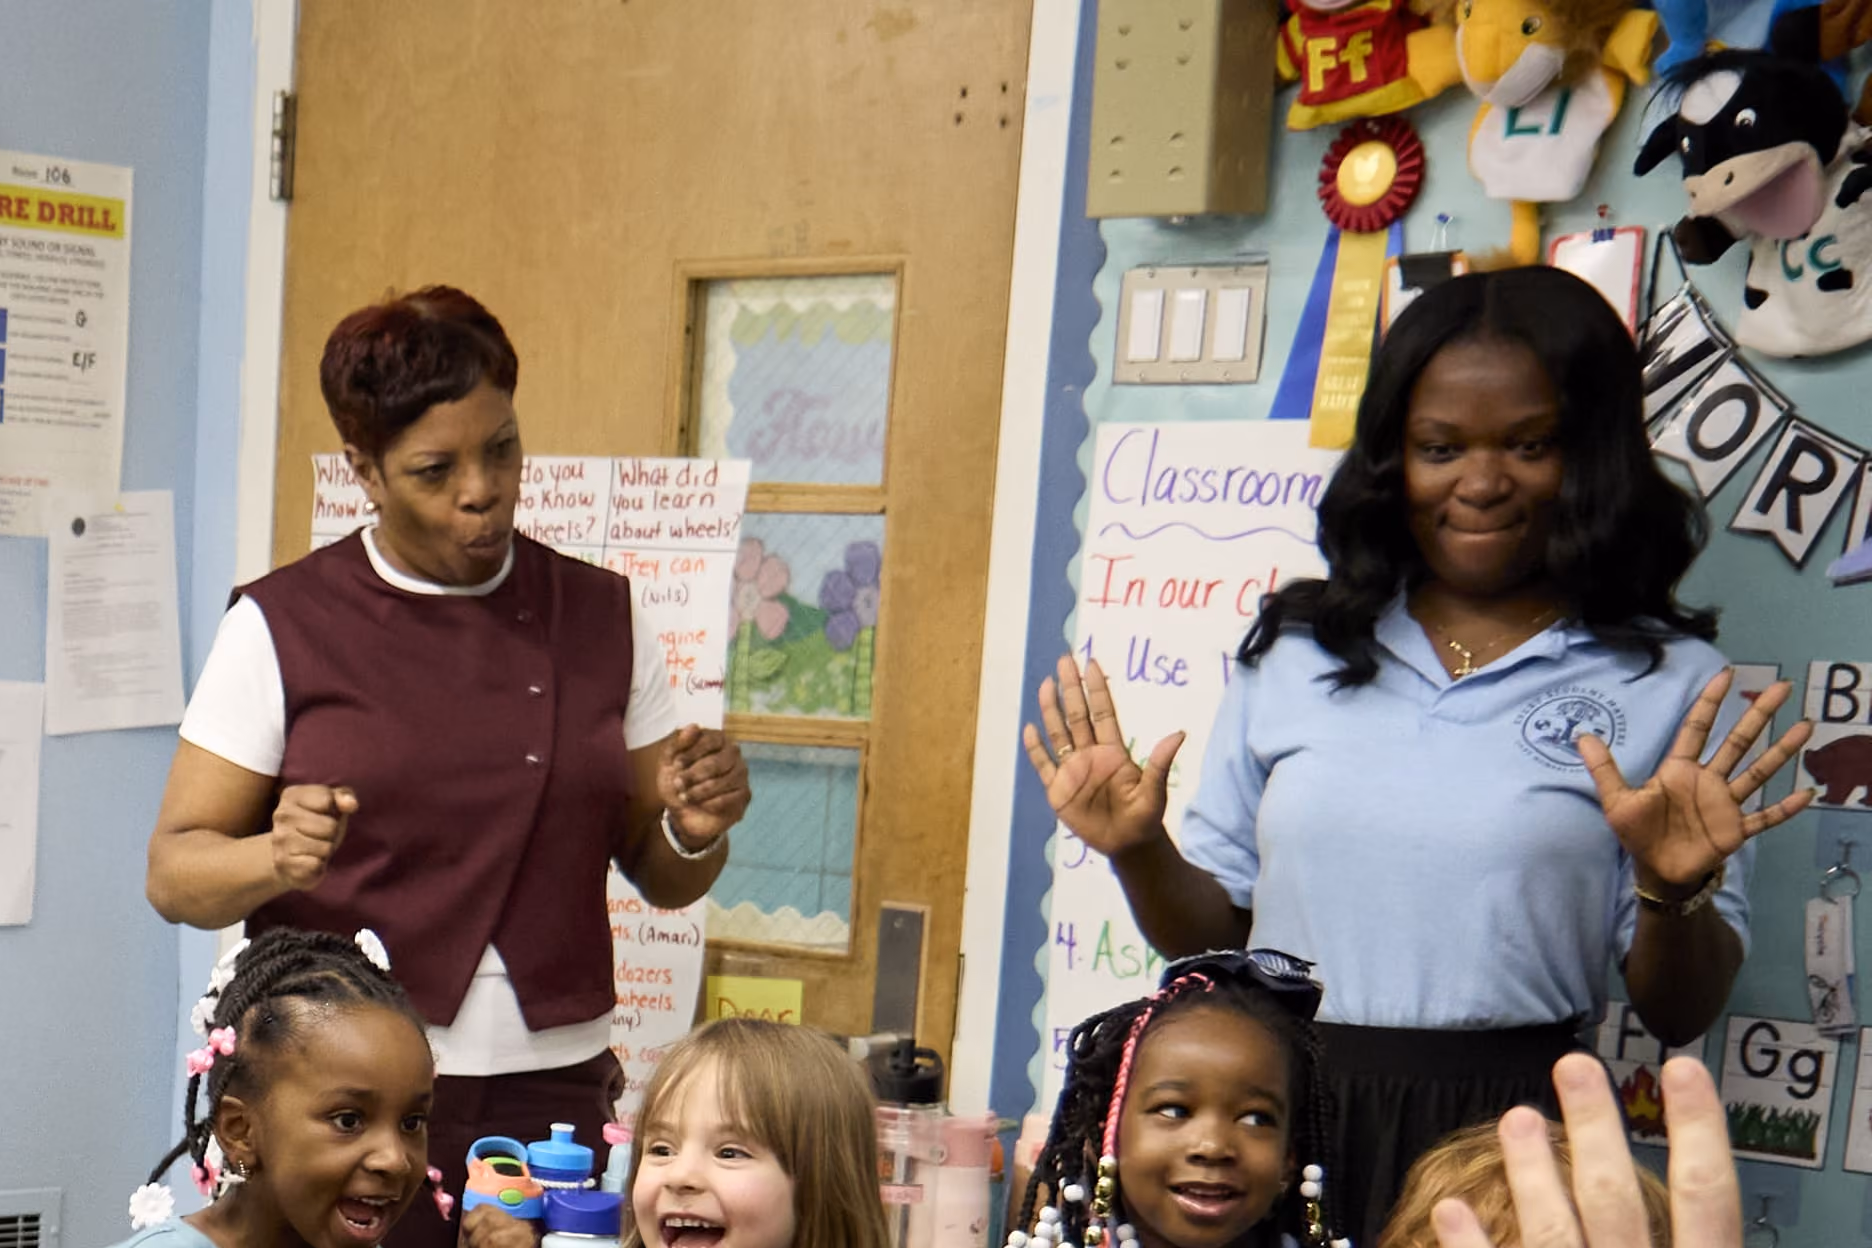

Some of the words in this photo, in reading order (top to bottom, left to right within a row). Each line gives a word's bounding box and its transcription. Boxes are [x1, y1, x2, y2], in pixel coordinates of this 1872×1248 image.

[1307, 29, 1373, 93] Ff
[46, 166, 71, 185] 106
[37, 200, 116, 231] DRILL
[549, 462, 584, 492] you
[618, 457, 669, 488] What
[676, 460, 719, 488] did
[1103, 427, 1323, 510] Classroom
[612, 493, 644, 516] you
[653, 490, 715, 511] learn
[610, 520, 661, 540] about
[669, 512, 742, 540] wheels?
[620, 551, 660, 581] They
[670, 557, 705, 575] can
[1085, 552, 1145, 609] In
[1158, 577, 1225, 610] our
[1128, 634, 1189, 687] Use
[1822, 663, 1872, 724] B
[638, 922, 701, 947] (Amari)
[1055, 921, 1083, 971] 4.
[716, 996, 793, 1021] Dr
[1740, 1021, 1825, 1100] Gg
